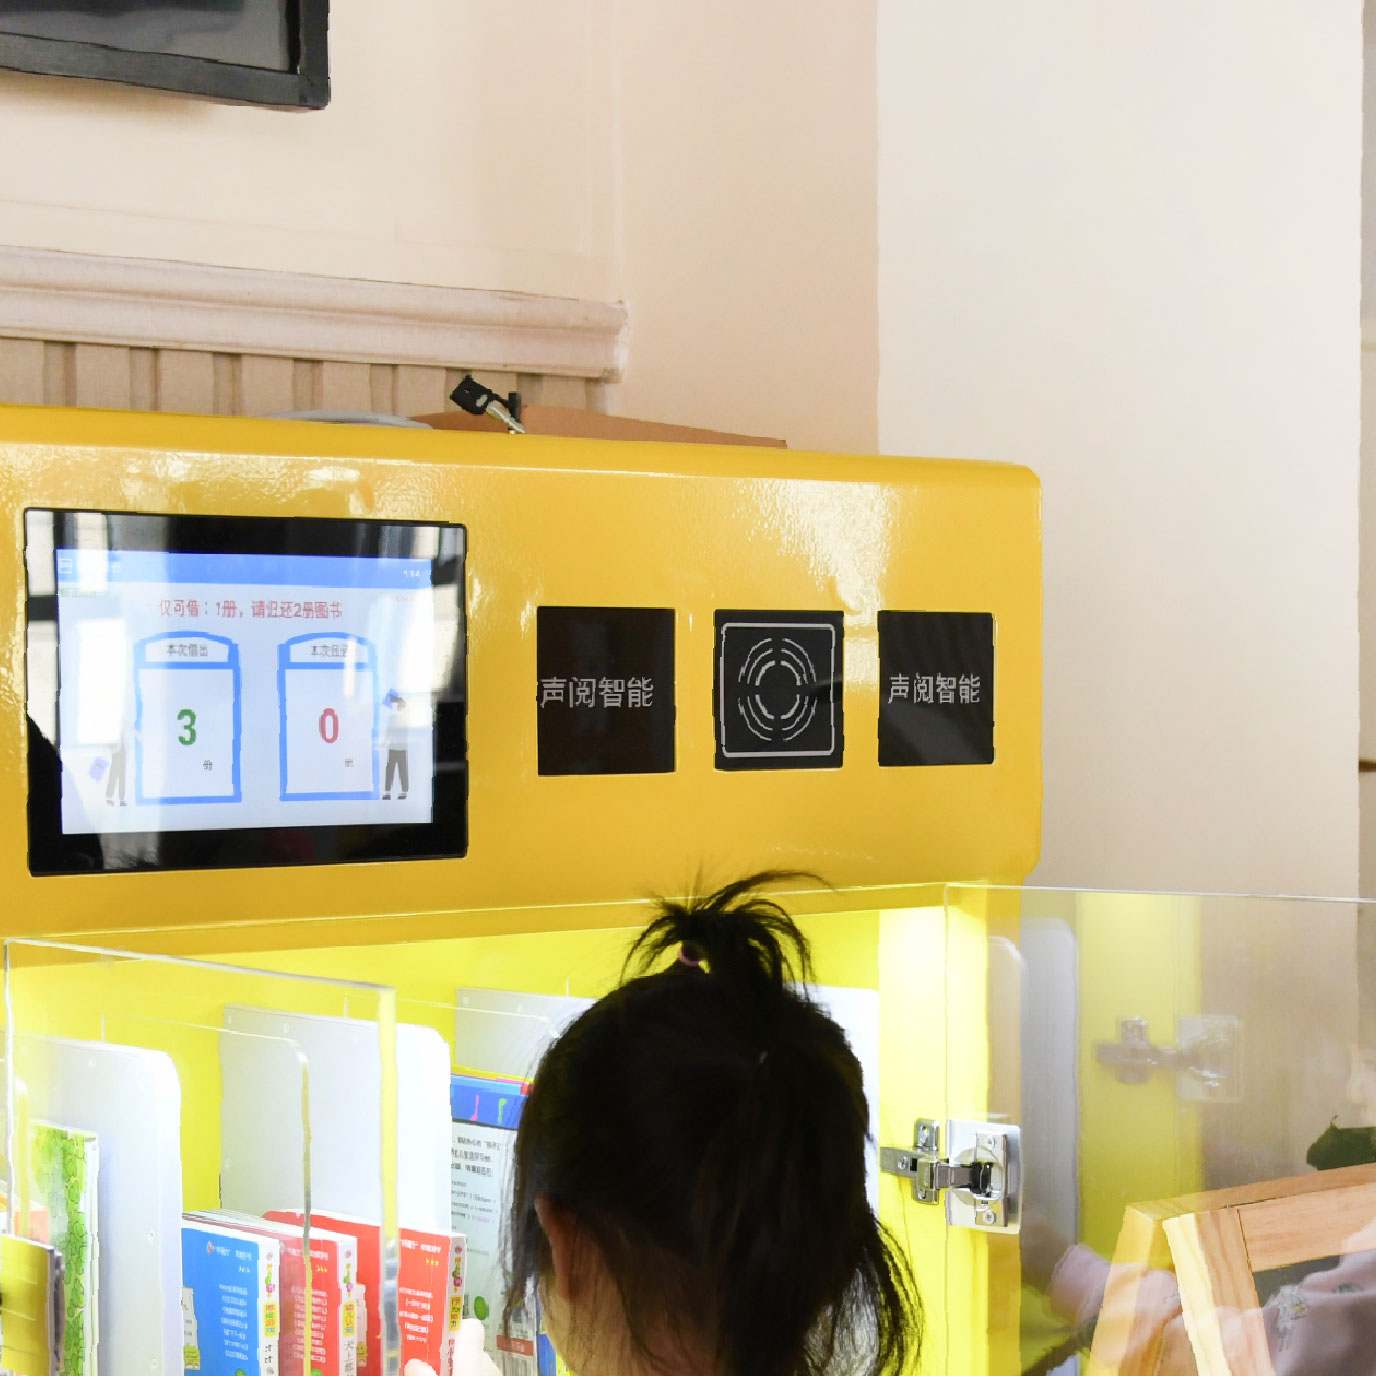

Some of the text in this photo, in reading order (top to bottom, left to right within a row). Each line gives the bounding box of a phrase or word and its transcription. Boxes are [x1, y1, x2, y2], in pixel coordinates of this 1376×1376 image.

[540, 676, 654, 708] 声阅智能
[887, 672, 981, 704] 声阅智能
[176, 708, 198, 746] 3
[318, 707, 340, 744] 0
